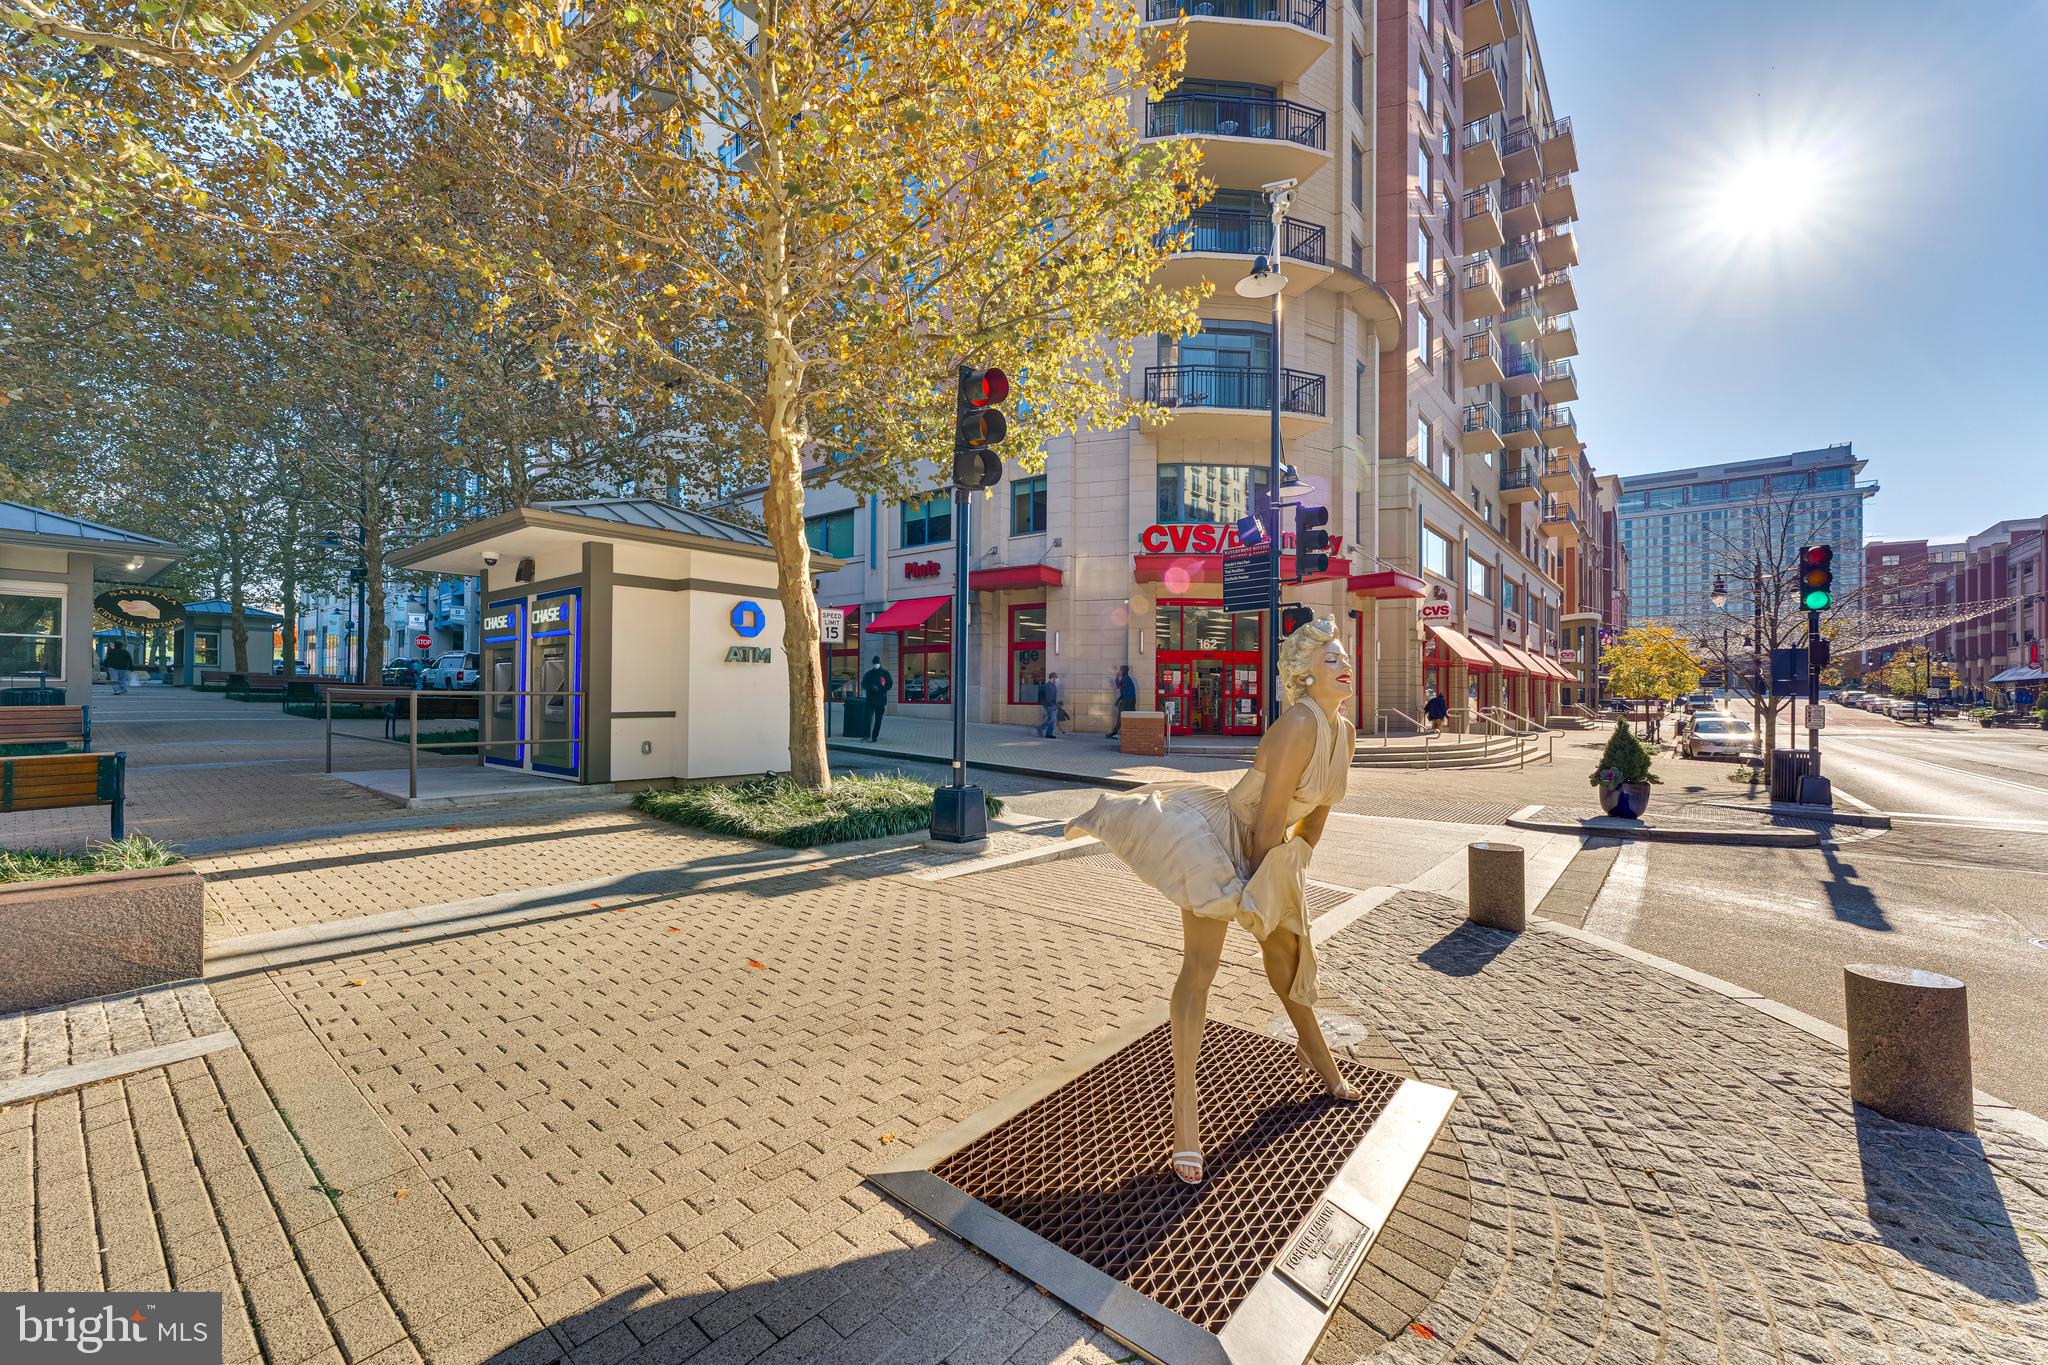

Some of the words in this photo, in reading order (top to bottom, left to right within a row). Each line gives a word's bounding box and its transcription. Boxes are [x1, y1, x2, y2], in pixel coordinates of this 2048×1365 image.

[108, 589, 177, 606] SABRINA
[532, 607, 560, 624] CHASE
[1423, 605, 1449, 616] CVS
[140, 617, 183, 629] ADVISOR
[484, 615, 508, 630] CHASE
[825, 627, 839, 639] 15
[1198, 639, 1217, 649] 162
[724, 646, 772, 663] ATM
[1286, 1235, 1314, 1270] FOREVER
[1308, 1206, 1335, 1238] MARILYN
